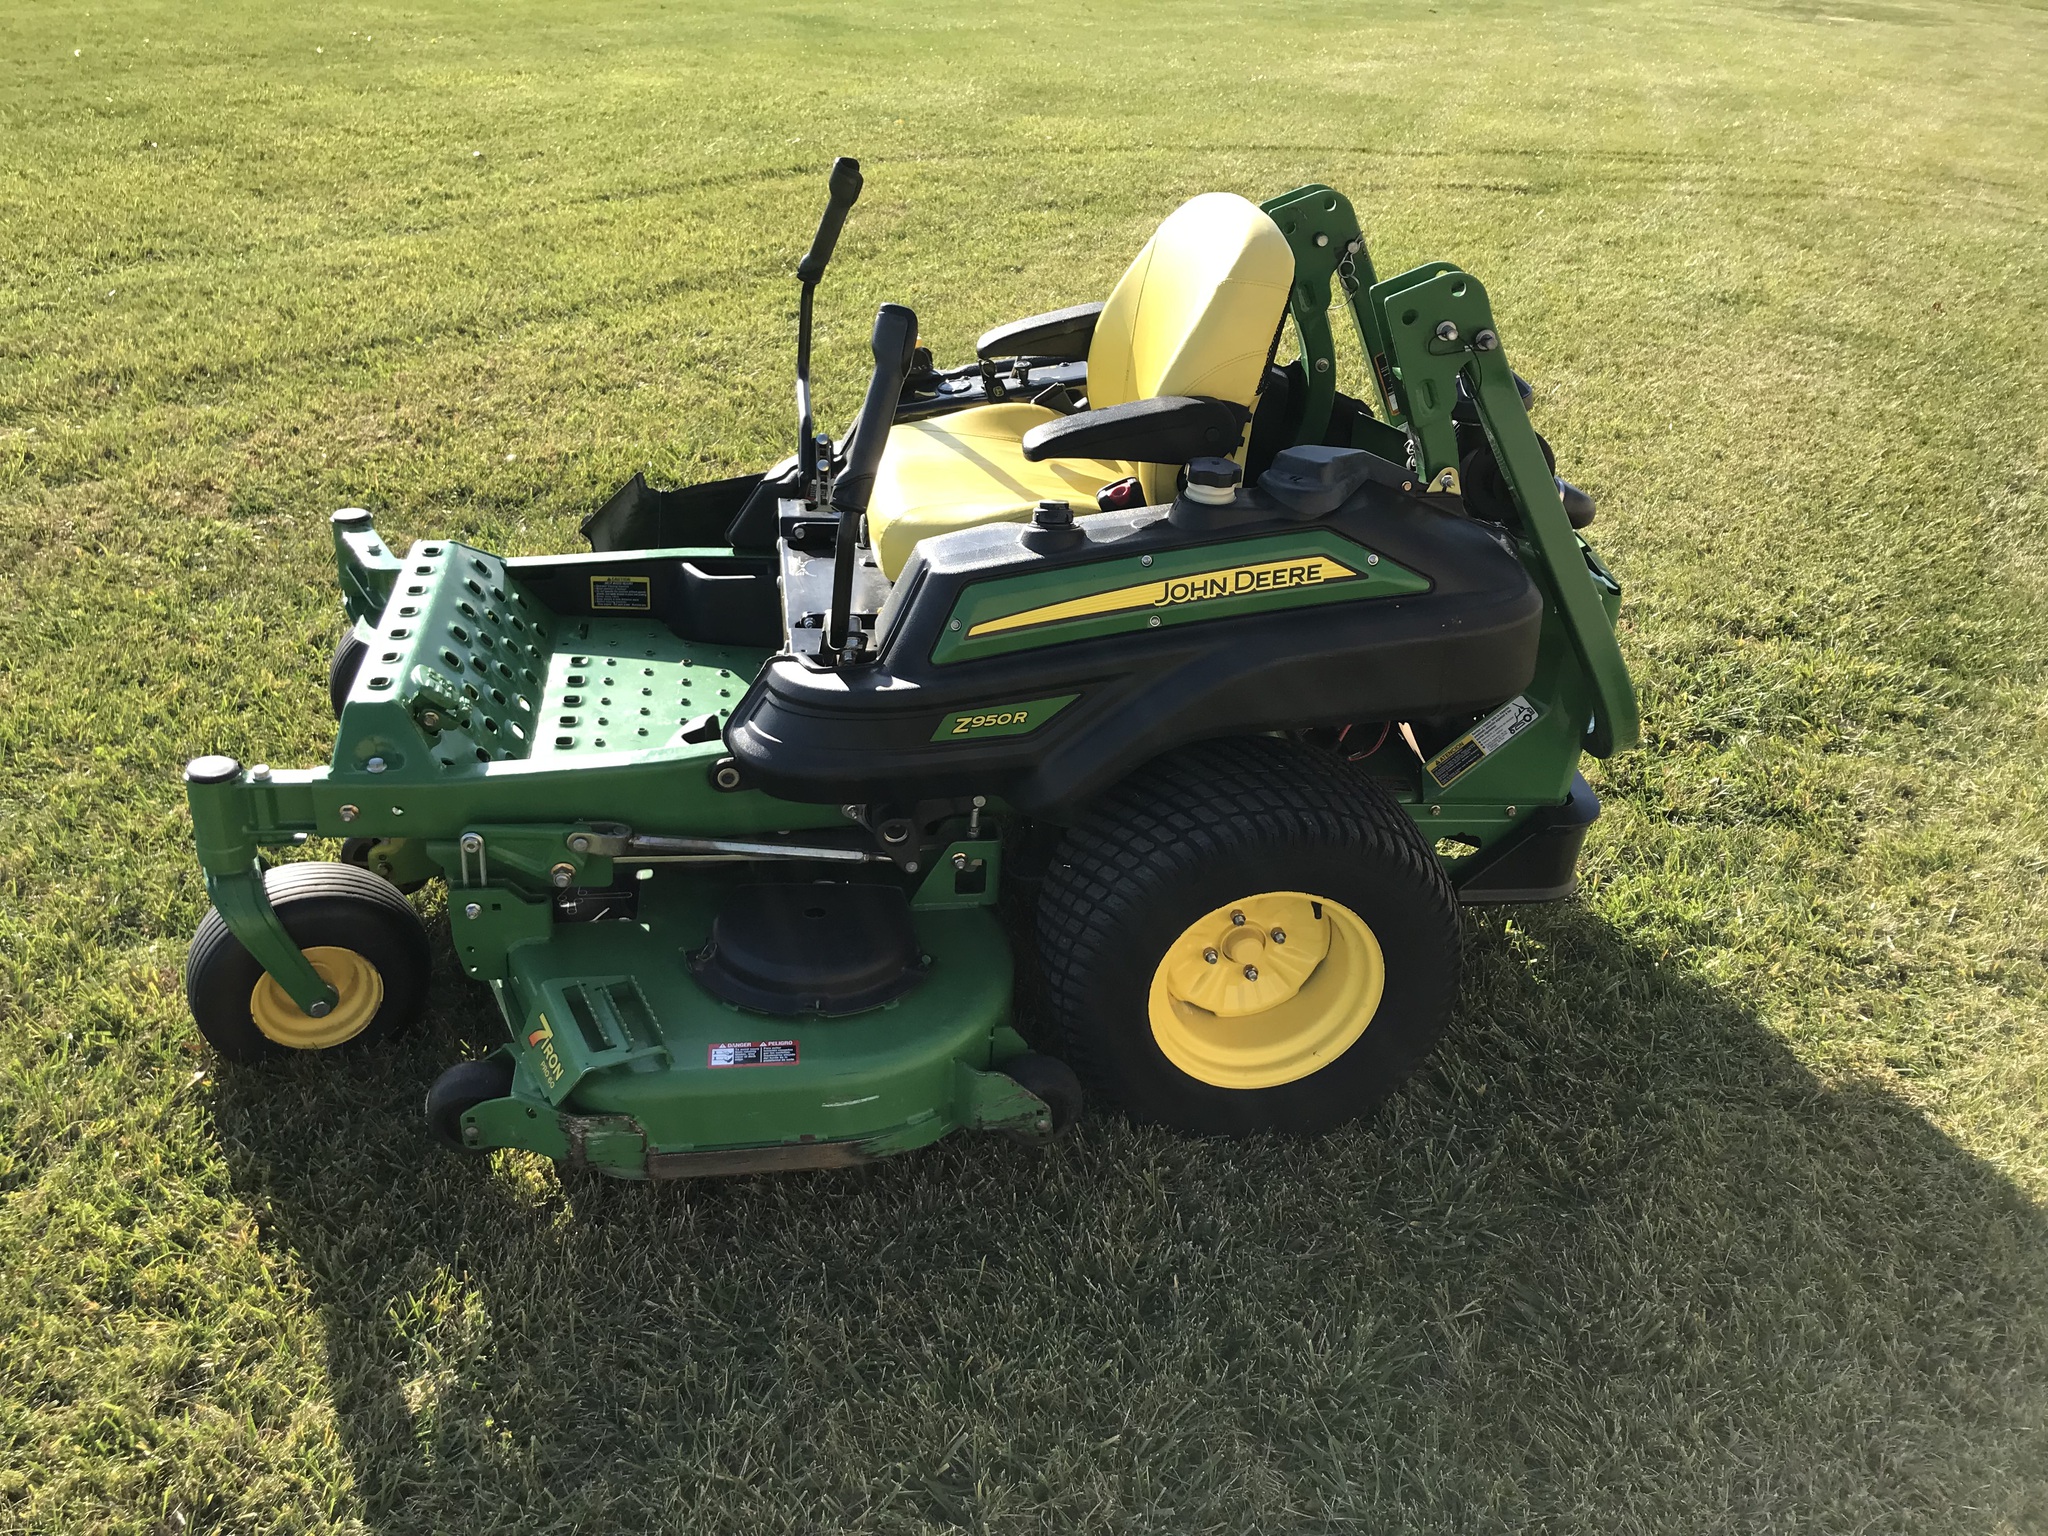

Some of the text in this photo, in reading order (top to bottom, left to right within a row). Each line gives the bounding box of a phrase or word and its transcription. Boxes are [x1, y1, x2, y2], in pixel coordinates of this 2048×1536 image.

[1154, 563, 1323, 605] JOHN DEERE
[952, 711, 1028, 734] Z950R
